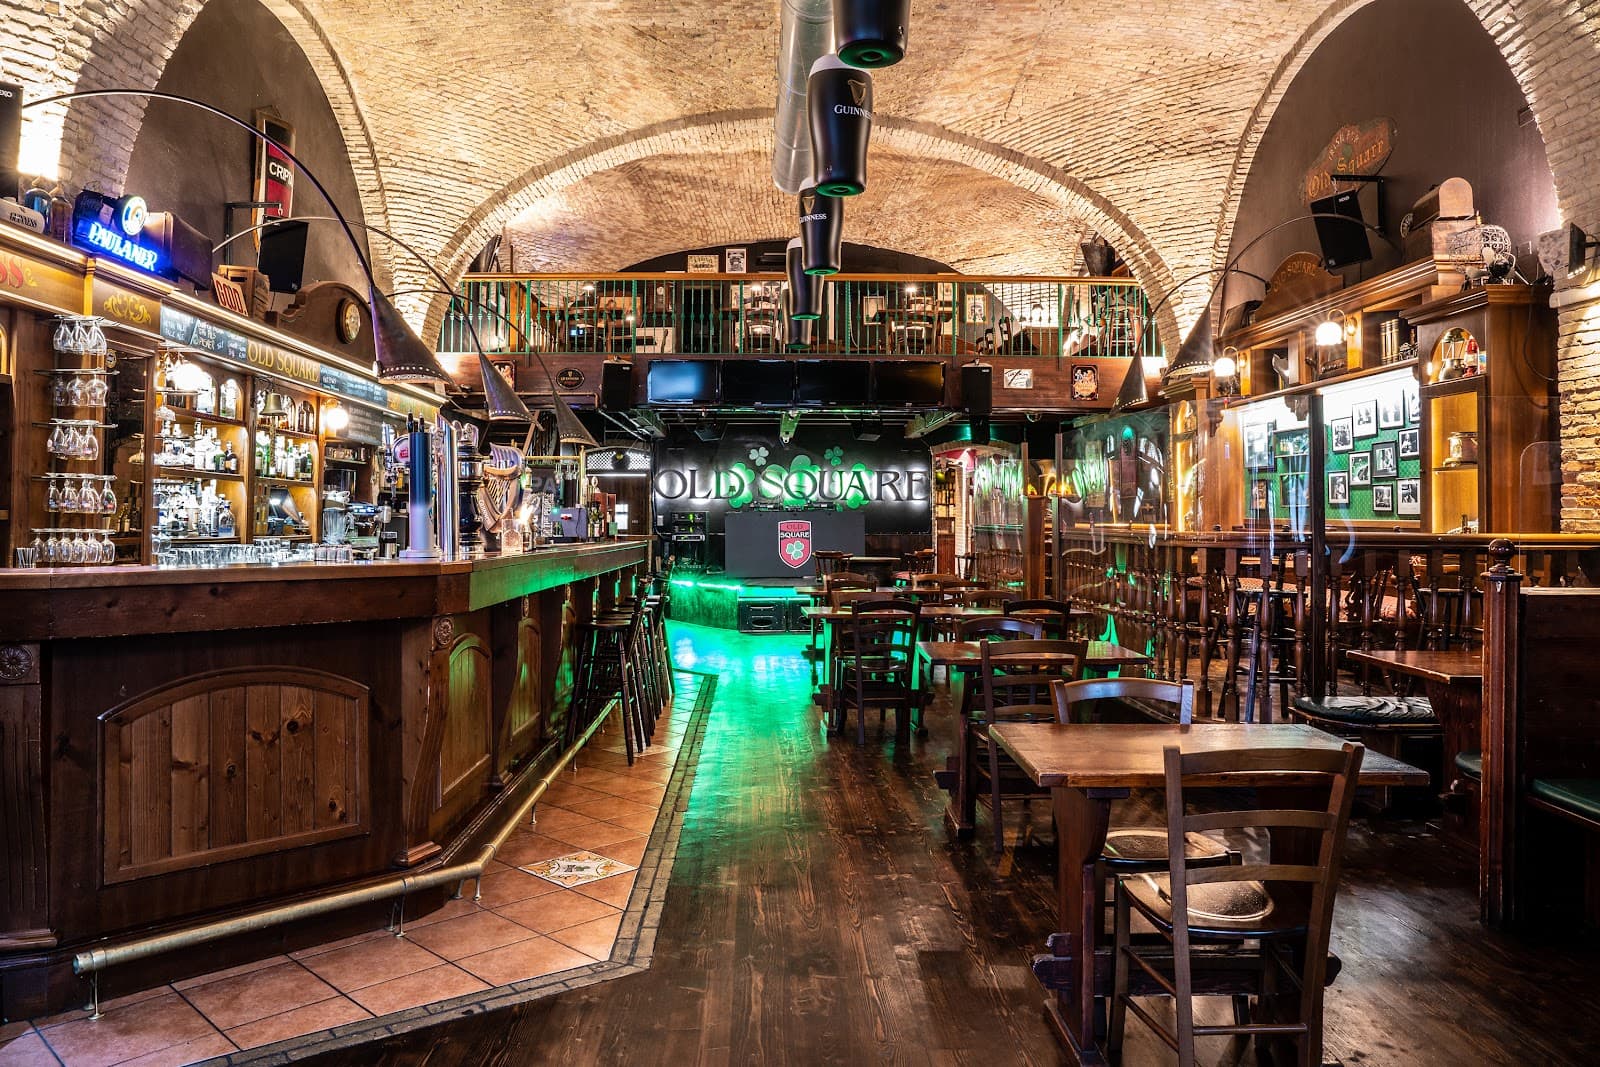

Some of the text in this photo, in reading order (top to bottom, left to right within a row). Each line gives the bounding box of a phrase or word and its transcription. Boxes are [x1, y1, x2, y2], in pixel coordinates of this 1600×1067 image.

[88, 222, 158, 272] PAULANER
[247, 342, 274, 369] OLD
[276, 350, 319, 383] SQUARE
[653, 468, 930, 502] OLD SQUARE
[780, 523, 810, 539] OLD SQUARE
